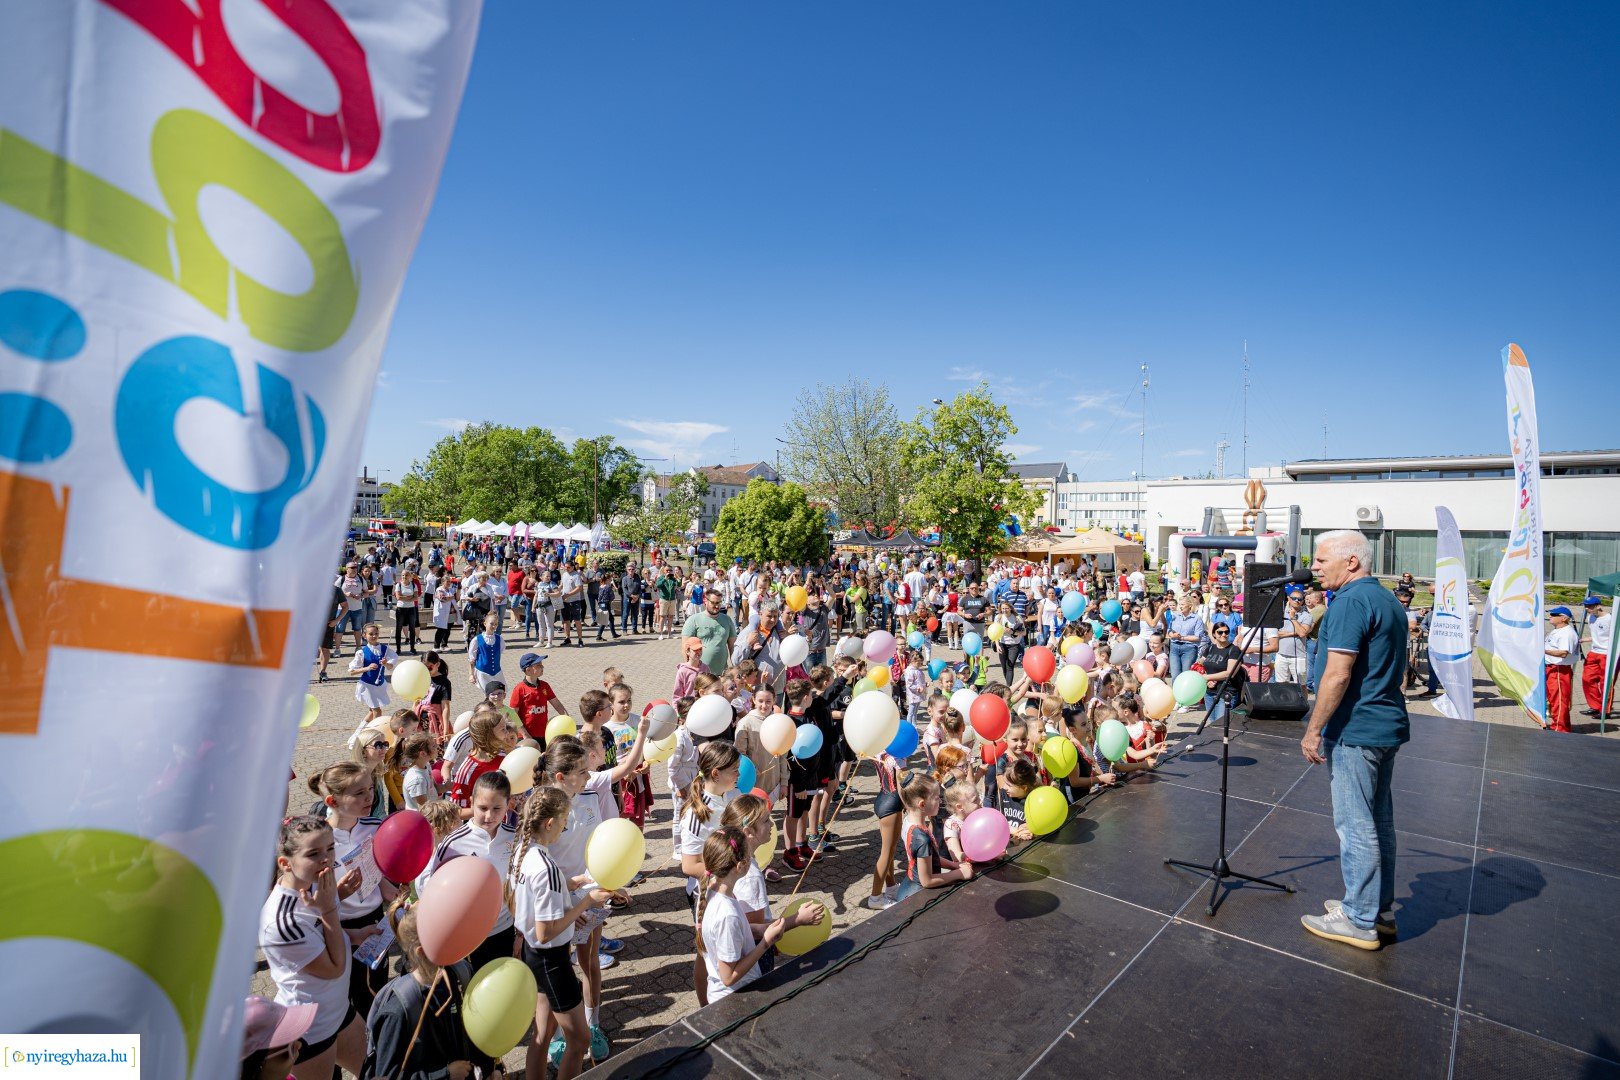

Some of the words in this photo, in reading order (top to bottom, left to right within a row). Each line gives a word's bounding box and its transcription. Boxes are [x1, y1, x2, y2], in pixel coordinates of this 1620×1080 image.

[1205, 654, 1223, 665] GAP
[531, 705, 546, 714] AON
[1004, 807, 1026, 821] ROOKL
